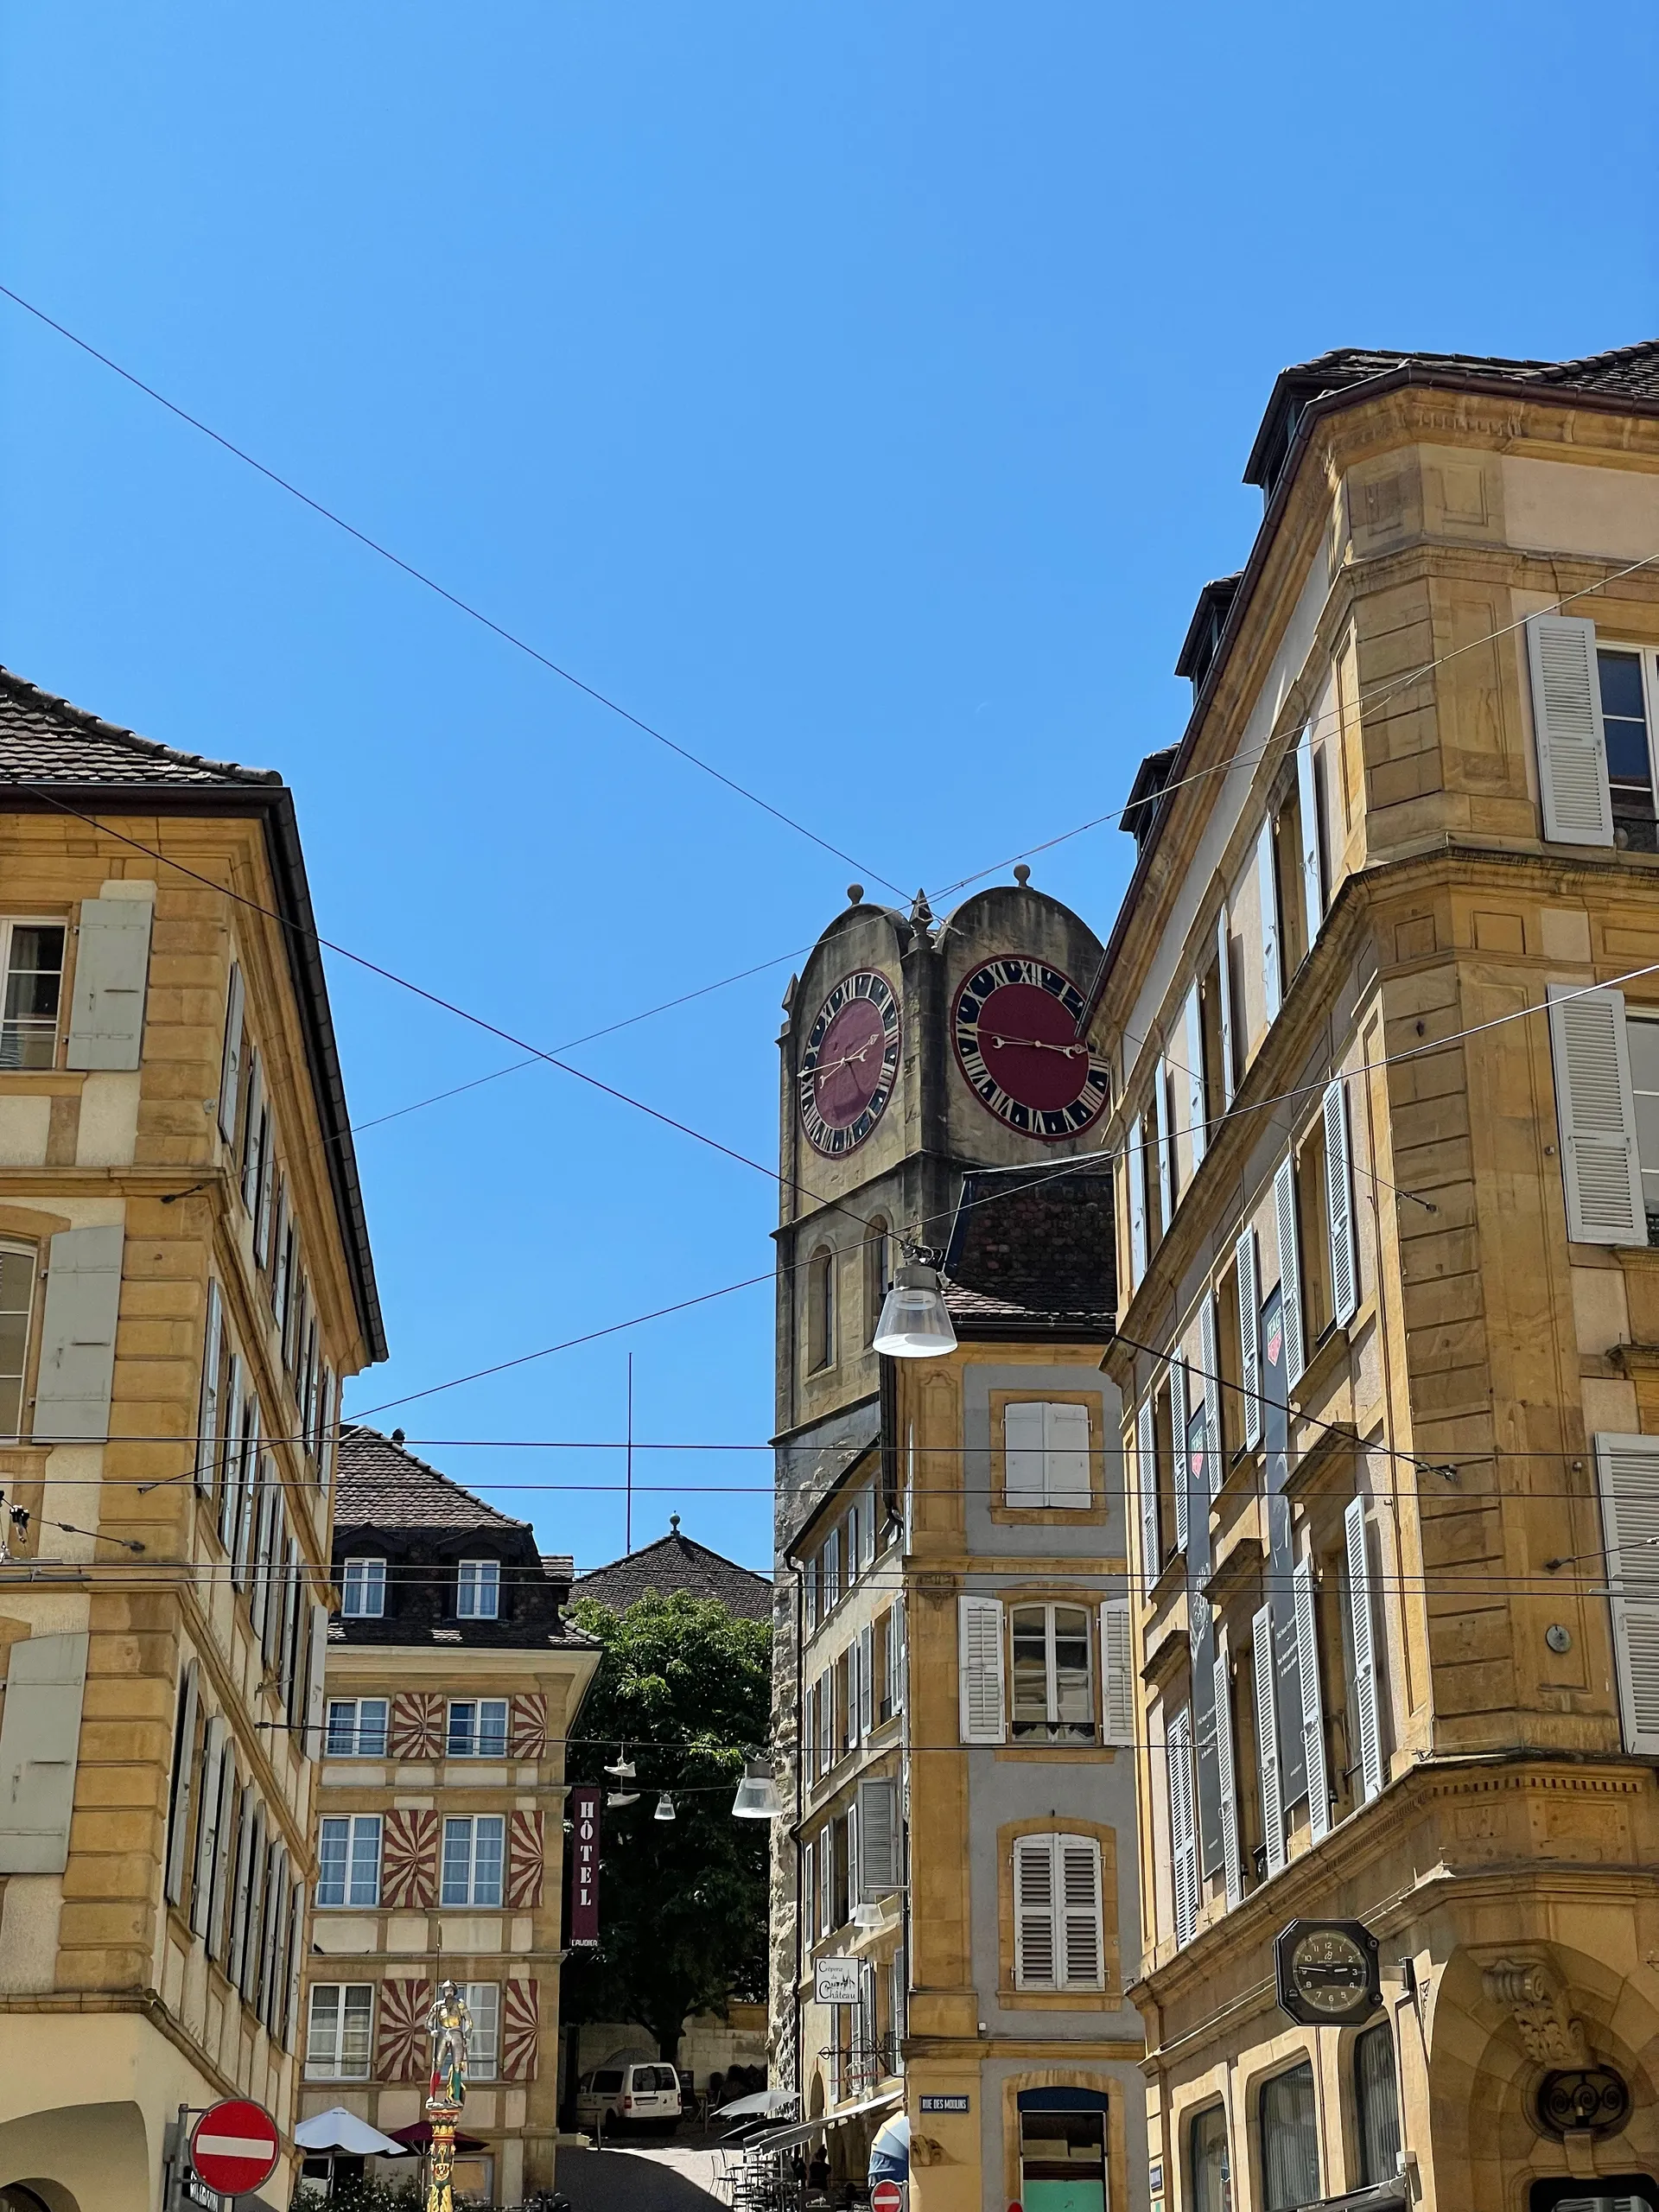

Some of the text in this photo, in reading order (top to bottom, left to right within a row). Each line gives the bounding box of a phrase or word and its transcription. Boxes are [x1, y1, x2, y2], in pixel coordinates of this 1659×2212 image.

[986, 963, 1010, 990] XI
[1019, 960, 1043, 988] XII
[963, 986, 986, 1007] X
[1058, 982, 1071, 1001] I
[962, 1052, 992, 1090] VIII
[988, 1087, 1015, 1123] VII
[1027, 1109, 1047, 1135] VI
[1062, 1108, 1080, 1133] V
[580, 1802, 594, 1906] HÔTEL
[819, 1980, 855, 1999] Château
[923, 2100, 966, 2108] RUE DES MOULINS
